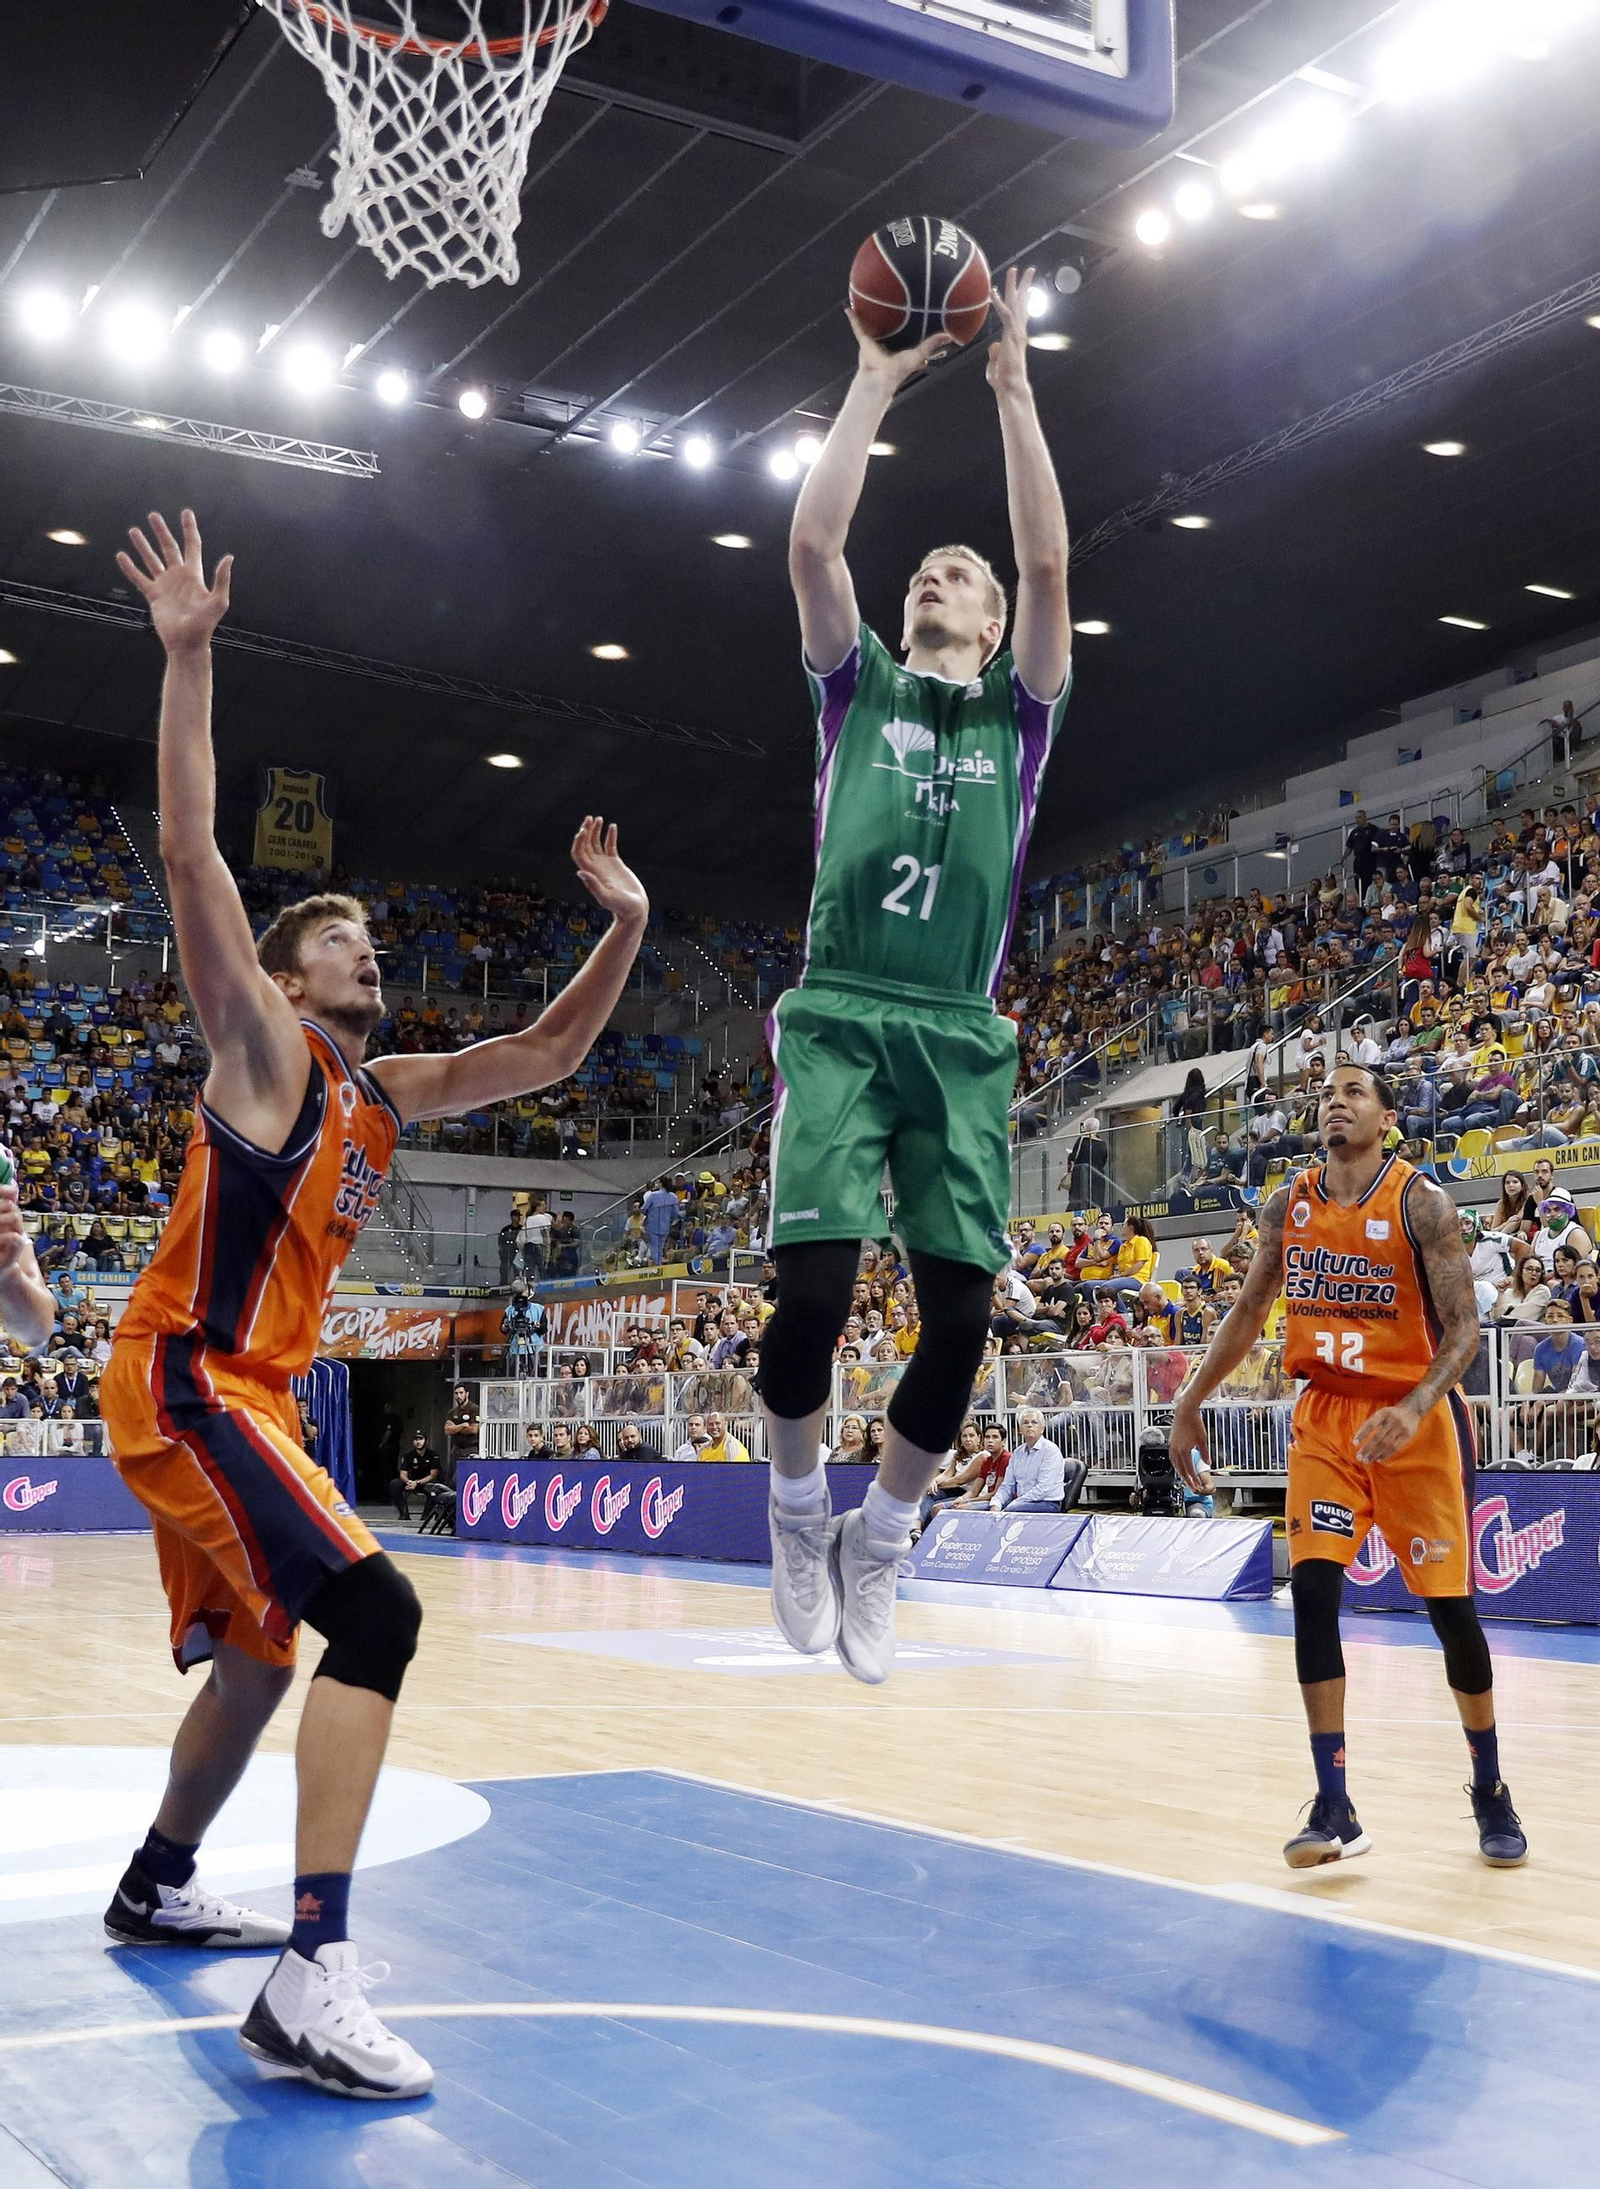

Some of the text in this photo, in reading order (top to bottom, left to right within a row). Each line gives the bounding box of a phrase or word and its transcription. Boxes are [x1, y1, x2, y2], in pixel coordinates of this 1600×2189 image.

[274, 797, 314, 833] 20
[267, 834, 318, 850] GRAN CANARIA
[881, 854, 942, 921] 21
[1555, 1148, 1579, 1165] GRAN
[1124, 1203, 1169, 1219] GRAN CANARIA
[1285, 1244, 1394, 1278] Cultura del
[77, 1273, 131, 1283] GRAN CANARIA
[1285, 1271, 1396, 1304] Esfuerzo
[1286, 1303, 1399, 1320] @ValenciaBasket
[321, 1306, 387, 1344] COPA
[365, 1317, 443, 1360] ENDESA
[1314, 1331, 1365, 1374] 32
[3, 1476, 58, 1511] Clipper
[462, 1472, 494, 1527] Clipper
[501, 1473, 536, 1530] Clipper
[544, 1474, 582, 1532] Clipper
[591, 1475, 631, 1535] Clipper
[640, 1476, 684, 1539] Clipper
[1314, 1503, 1354, 1520] PULEVA
[940, 1541, 982, 1552] supercopa
[944, 1551, 976, 1561] endesa
[1005, 1545, 1050, 1556] supercopa
[1099, 1550, 1146, 1561] supercopa
[1472, 1495, 1565, 1593] Clipper
[920, 1559, 970, 1570] Gran Canaria 2017
[985, 1564, 1037, 1574] Gran Canaria 2017
[1010, 1556, 1043, 1566] endesa
[1104, 1561, 1140, 1572] endesa
